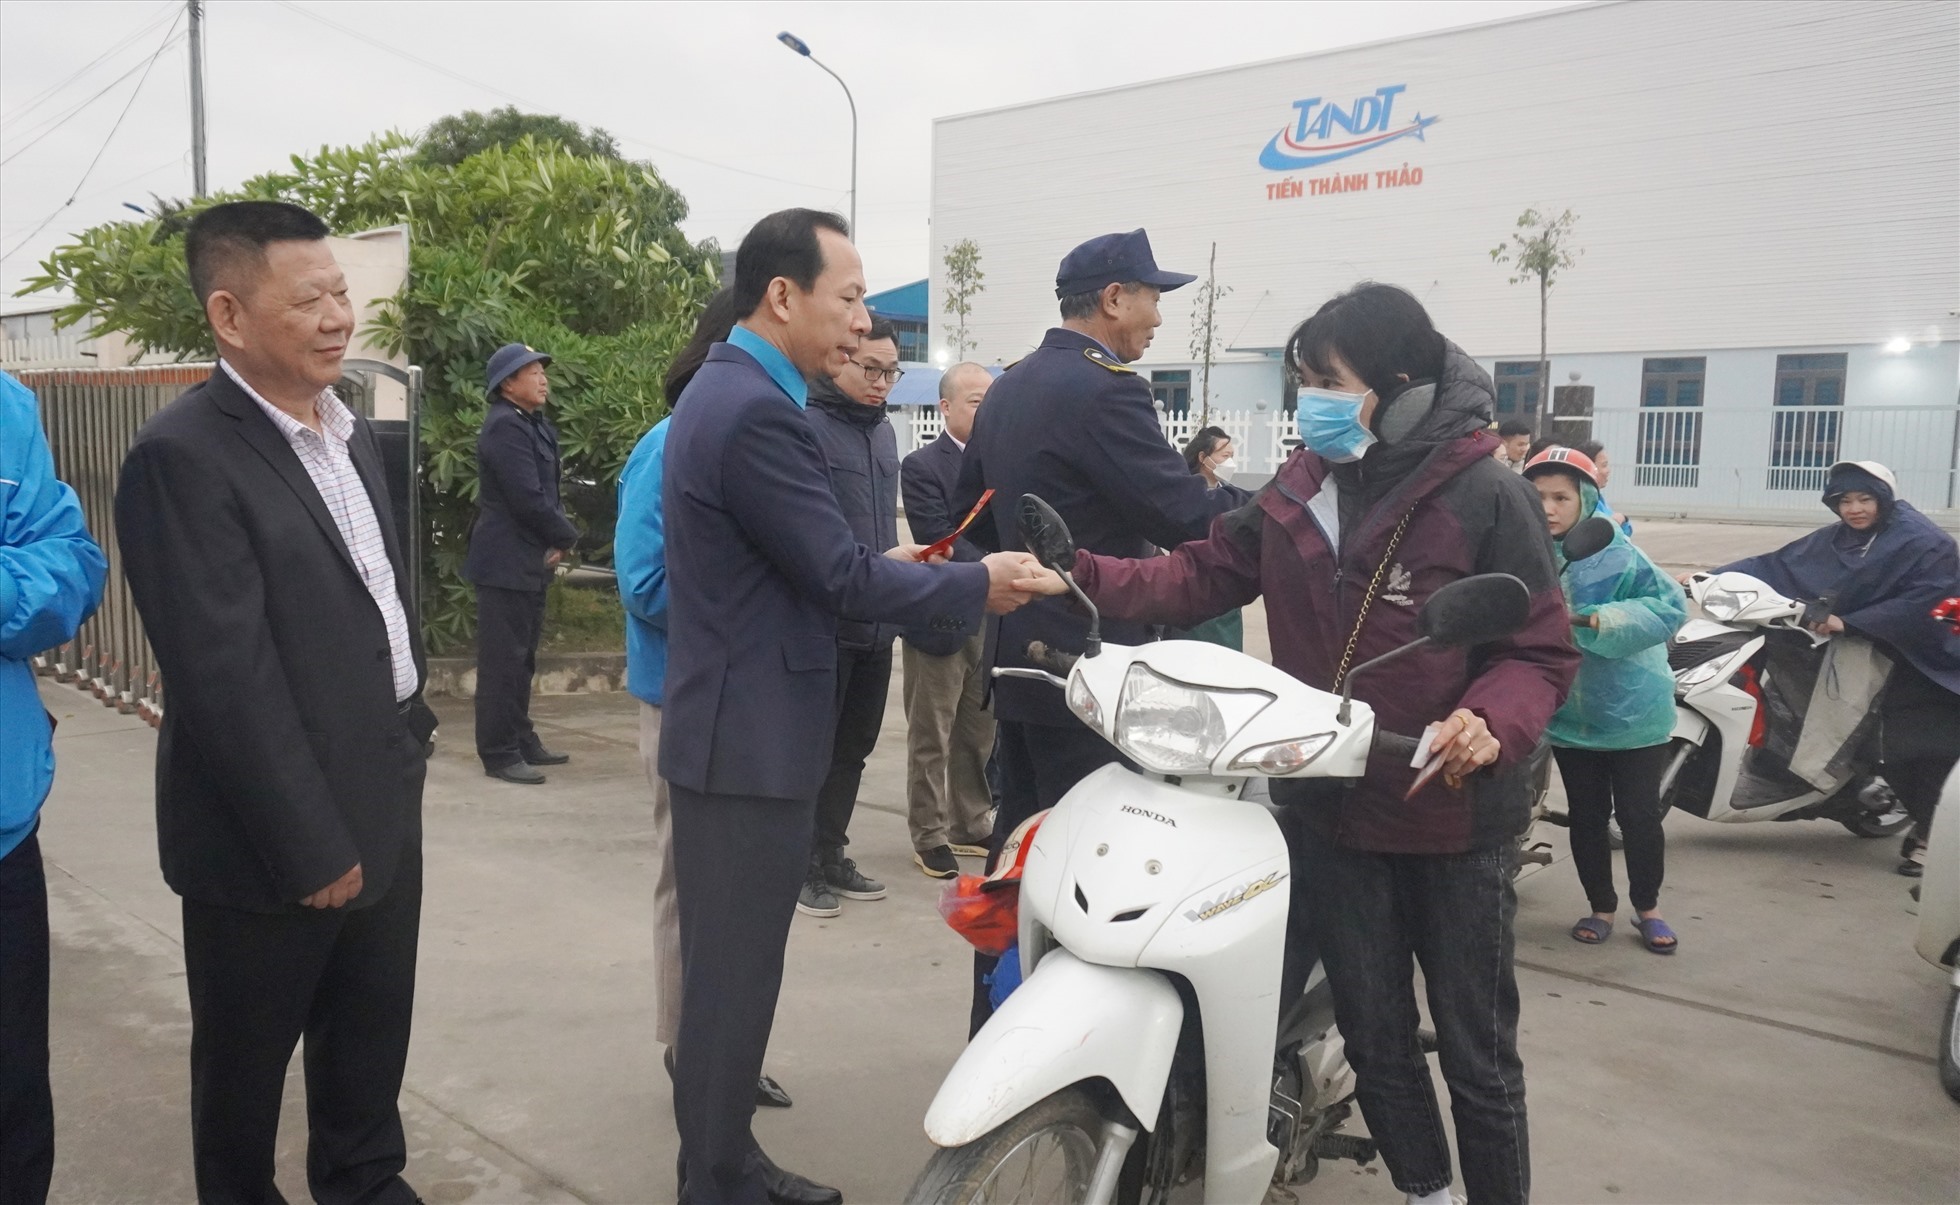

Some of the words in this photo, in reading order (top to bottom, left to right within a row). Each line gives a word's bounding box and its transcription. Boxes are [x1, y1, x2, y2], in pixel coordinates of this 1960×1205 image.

[1292, 83, 1406, 142] TANDT
[1266, 176, 1303, 200] TIẾN
[1309, 172, 1368, 195] THÀNH
[1375, 162, 1423, 189] THẢO
[1120, 805, 1177, 828] HONDA
